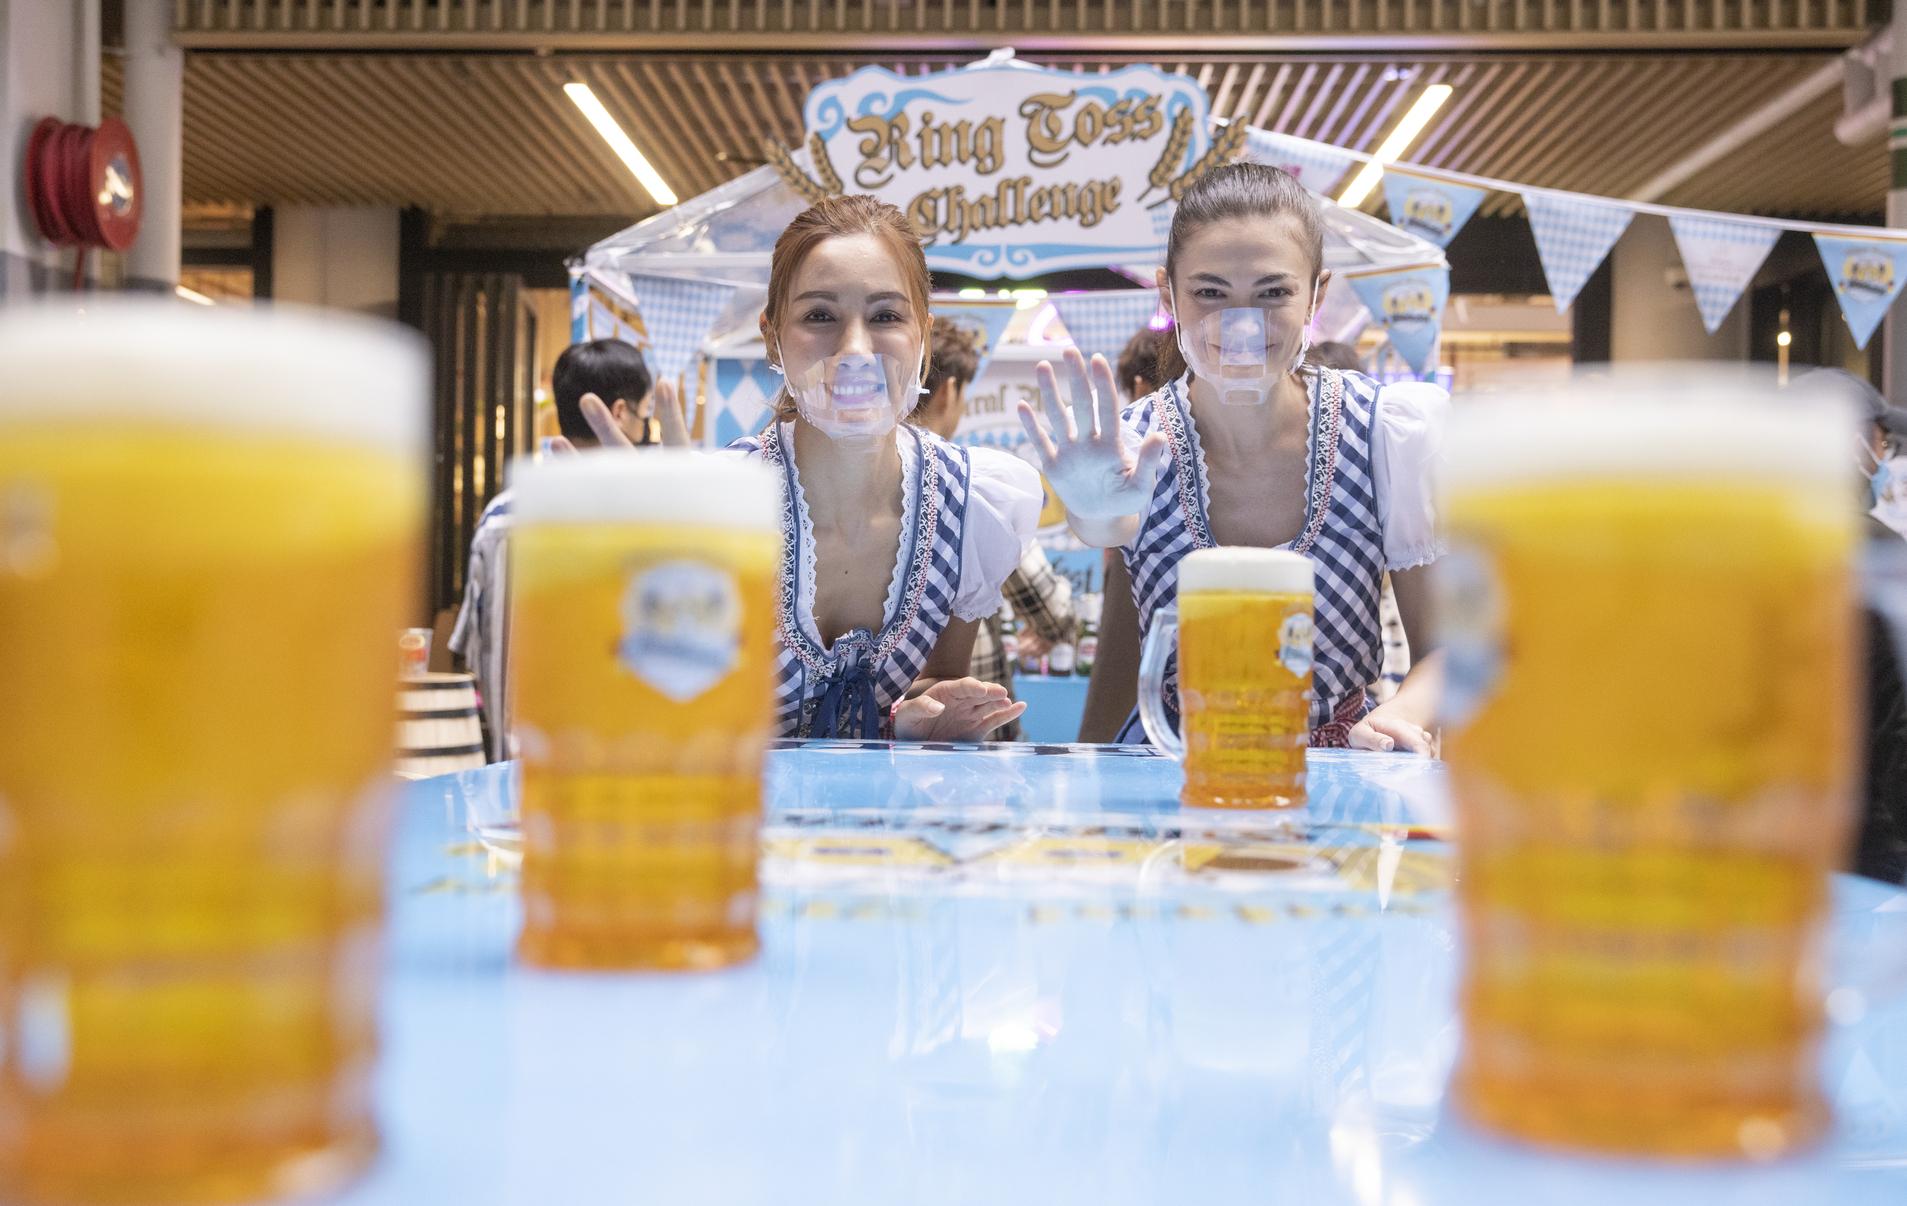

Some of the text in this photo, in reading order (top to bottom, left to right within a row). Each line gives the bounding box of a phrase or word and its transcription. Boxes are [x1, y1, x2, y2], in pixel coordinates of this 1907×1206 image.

[846, 90, 1164, 189] Ring Toss
[906, 174, 1122, 249] Challenge
